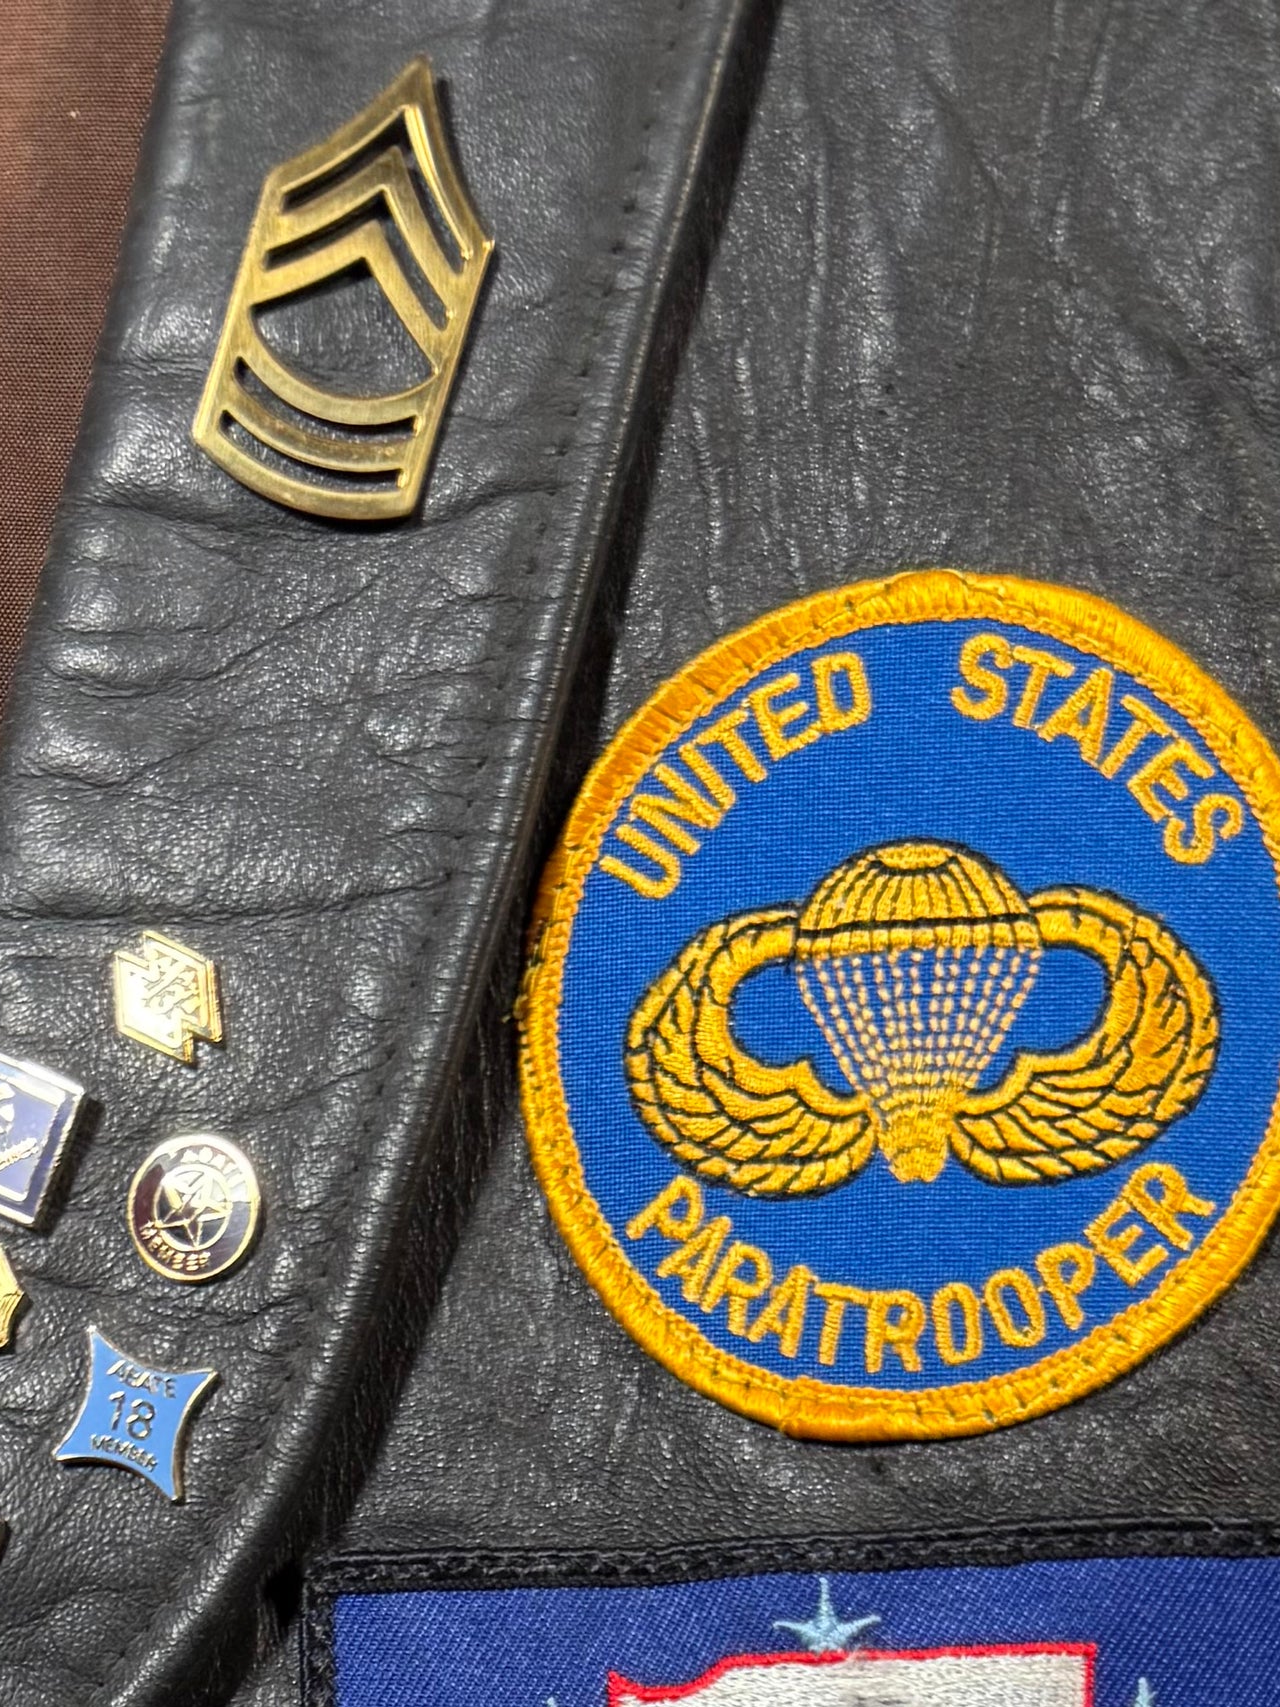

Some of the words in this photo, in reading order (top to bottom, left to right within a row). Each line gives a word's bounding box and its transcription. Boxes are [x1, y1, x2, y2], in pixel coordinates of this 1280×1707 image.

[600, 652, 872, 899] UNITED
[951, 633, 1245, 866] STATES
[625, 1161, 1216, 1374] PARATROOPER
[90, 1433, 159, 1473] MEMBER
[108, 1390, 156, 1440] 18
